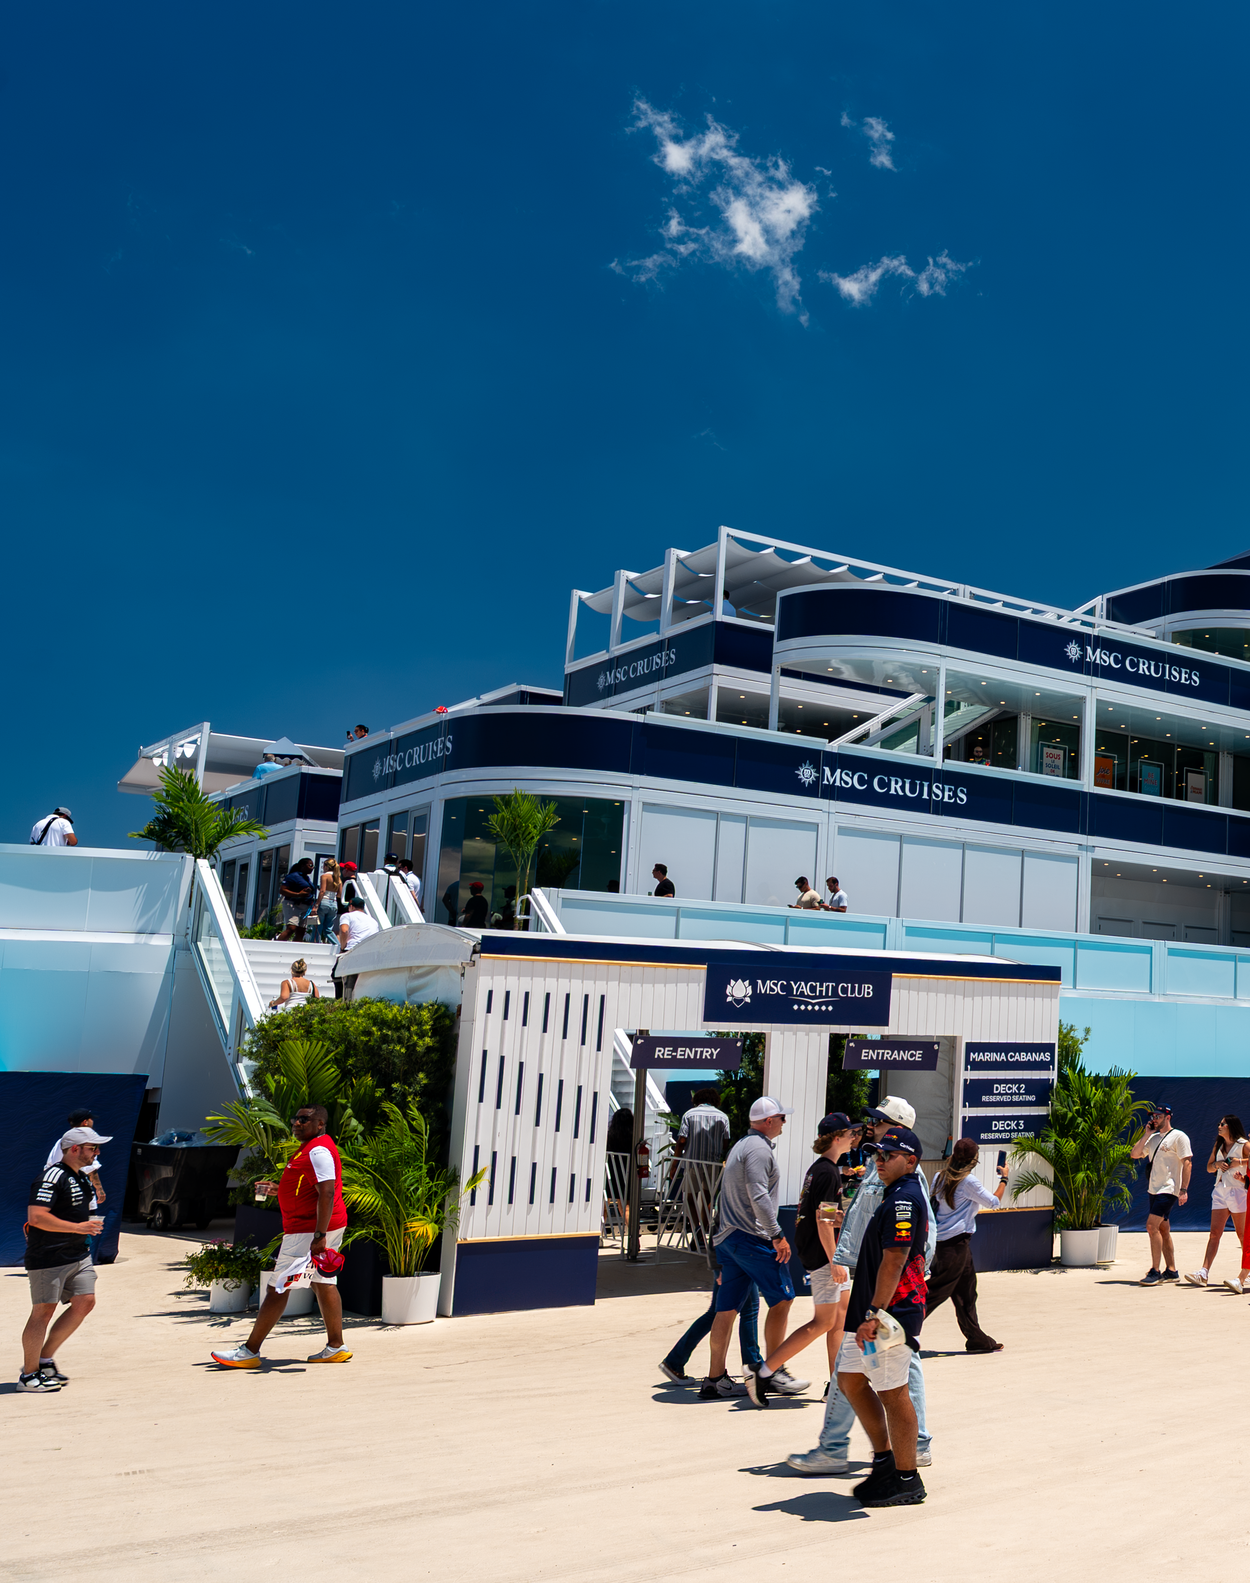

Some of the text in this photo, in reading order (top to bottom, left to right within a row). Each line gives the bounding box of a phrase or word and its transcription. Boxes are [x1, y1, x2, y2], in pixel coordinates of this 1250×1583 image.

[605, 648, 676, 686] MSC CRUISES
[1085, 646, 1200, 686] MSC CRUISES
[382, 735, 453, 775] MSC CRUISES
[1046, 752, 1061, 760] SOUS
[822, 766, 967, 805] MSC CRUISES
[756, 979, 873, 998] MSC YACHT CLUB
[654, 1047, 720, 1060] RE-ENTRY
[861, 1049, 923, 1061] ENTRANCE
[969, 1052, 1051, 1062] MARINA CABANAS
[993, 1084, 1026, 1093] DECK 2
[992, 1120, 1024, 1130] DECK 3
